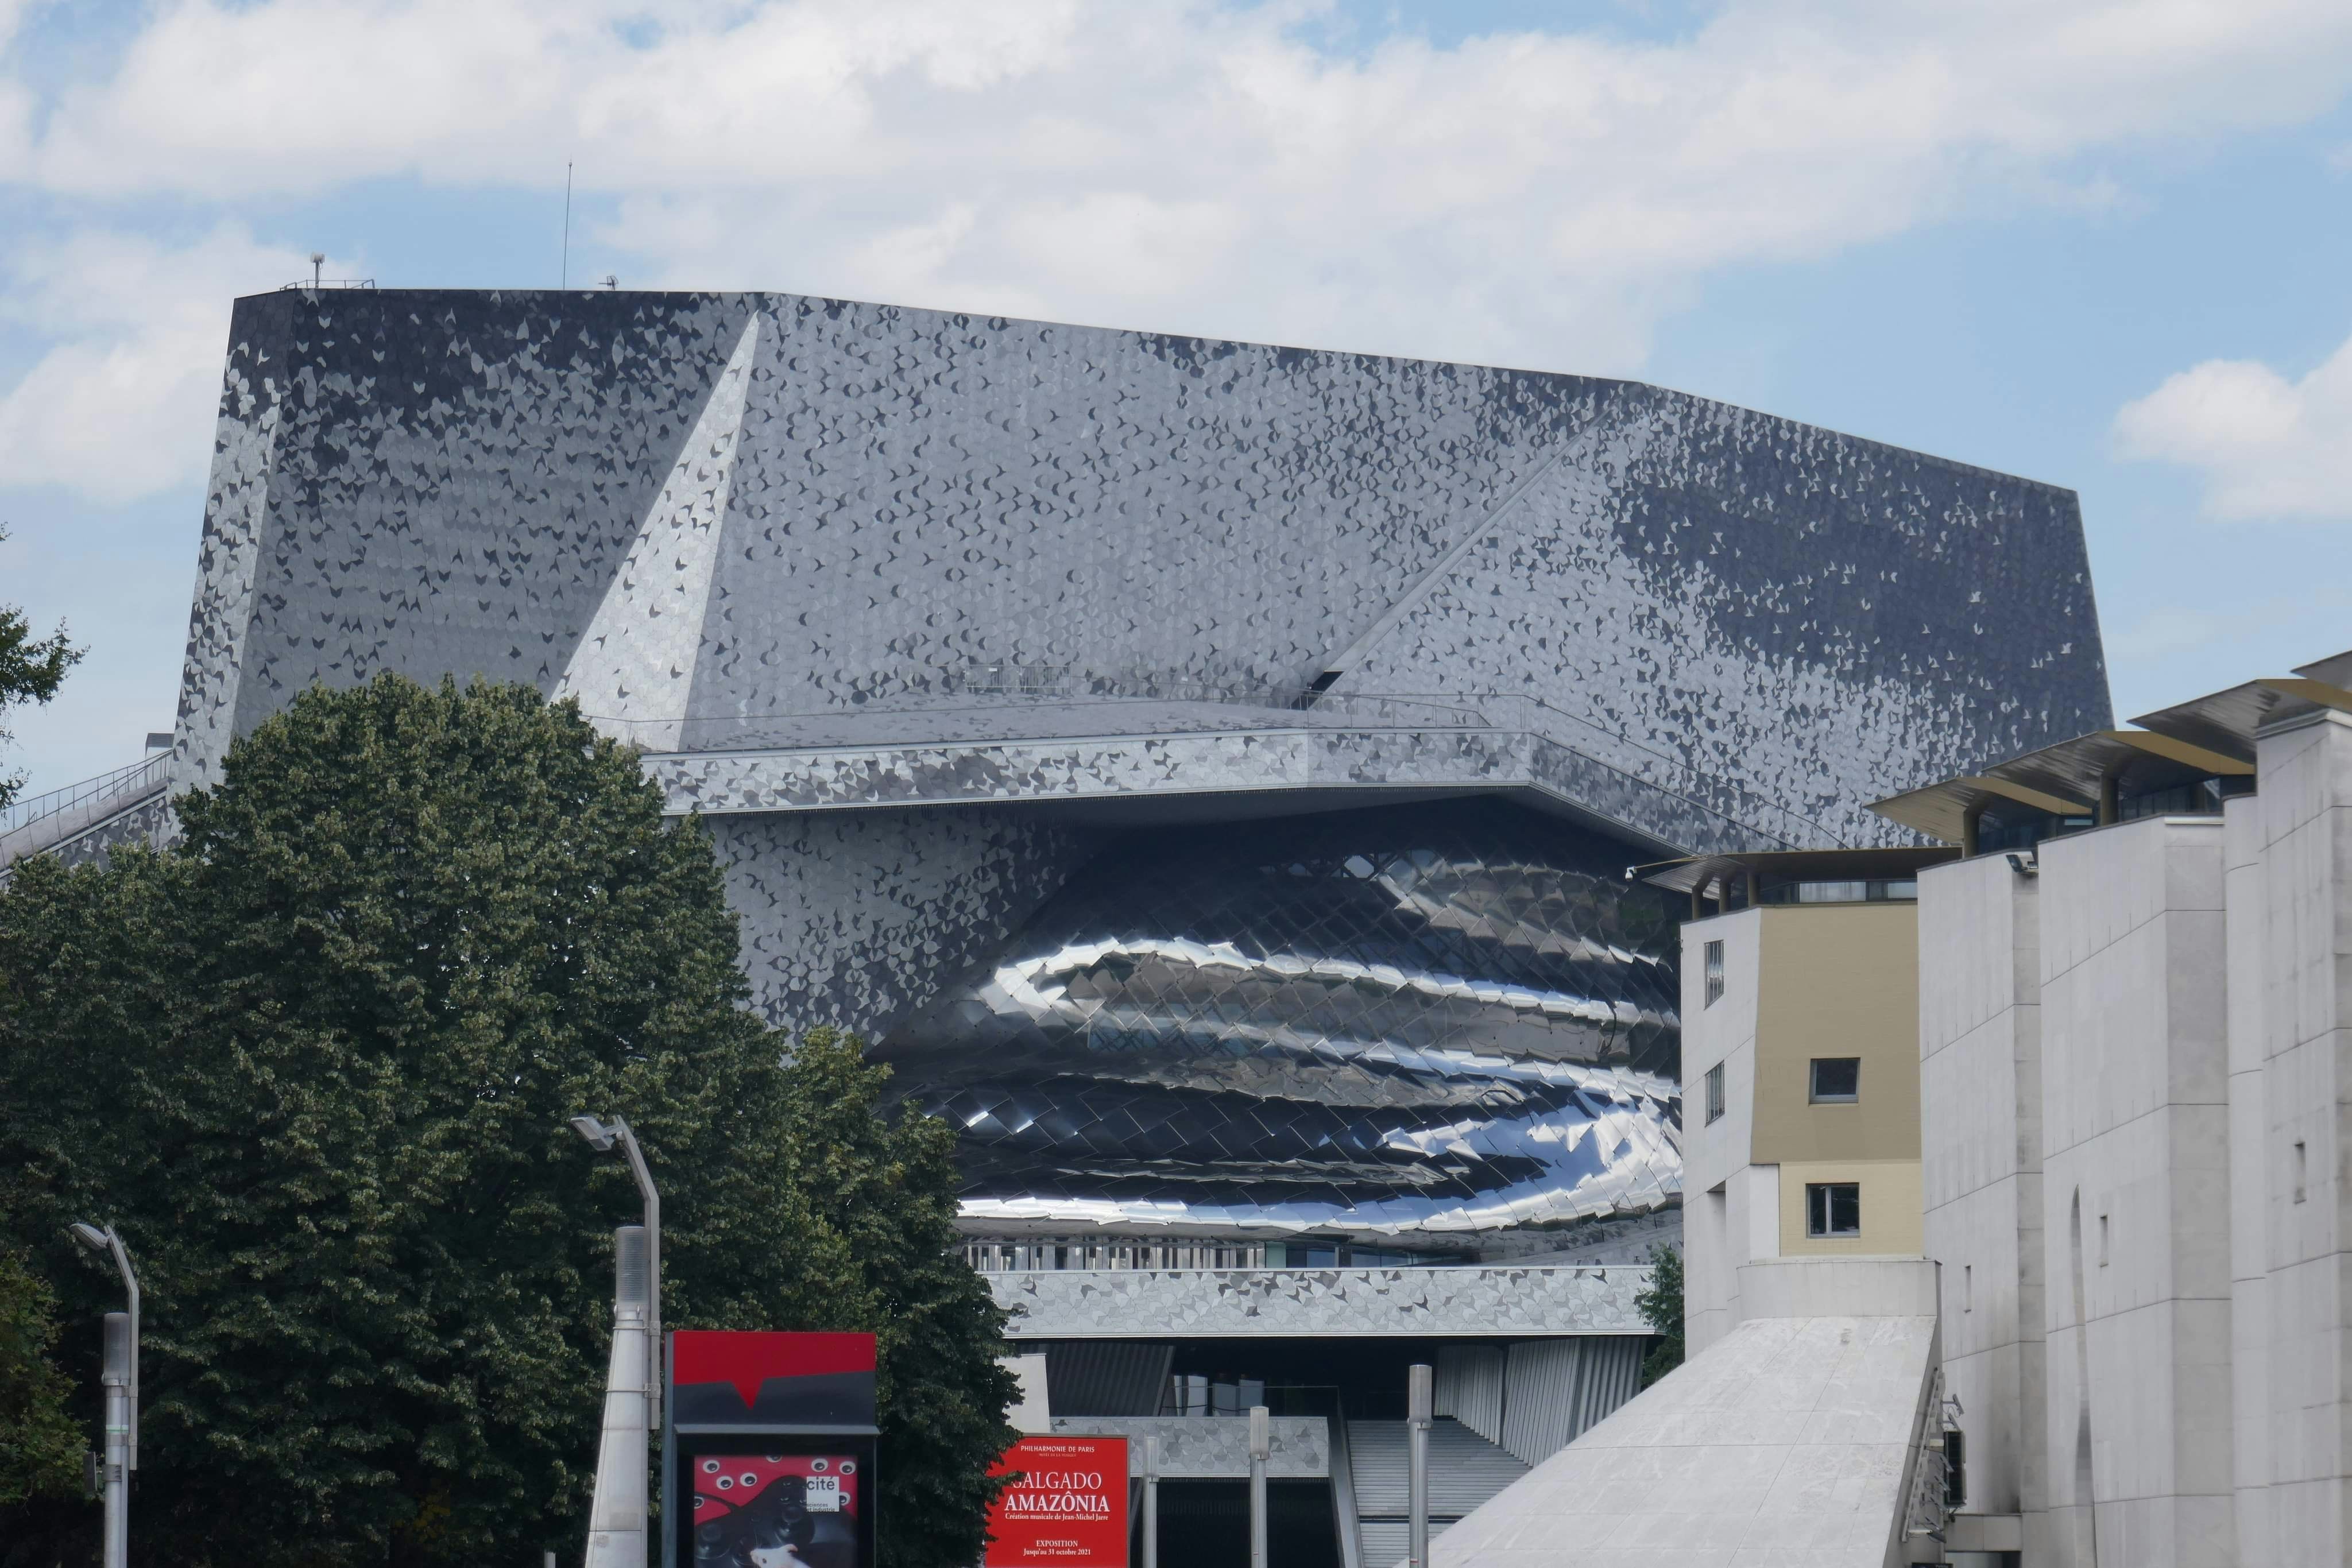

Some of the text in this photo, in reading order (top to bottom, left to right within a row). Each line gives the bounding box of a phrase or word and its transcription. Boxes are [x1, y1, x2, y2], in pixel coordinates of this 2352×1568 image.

[807, 1476, 835, 1490] cité
[1004, 1490, 1111, 1512] AMAZÔNIA
[1062, 1513, 1094, 1521] Jean-Michel
[1095, 1513, 1109, 1521] Jarre
[1023, 1548, 1047, 1557] Jusqu'au
